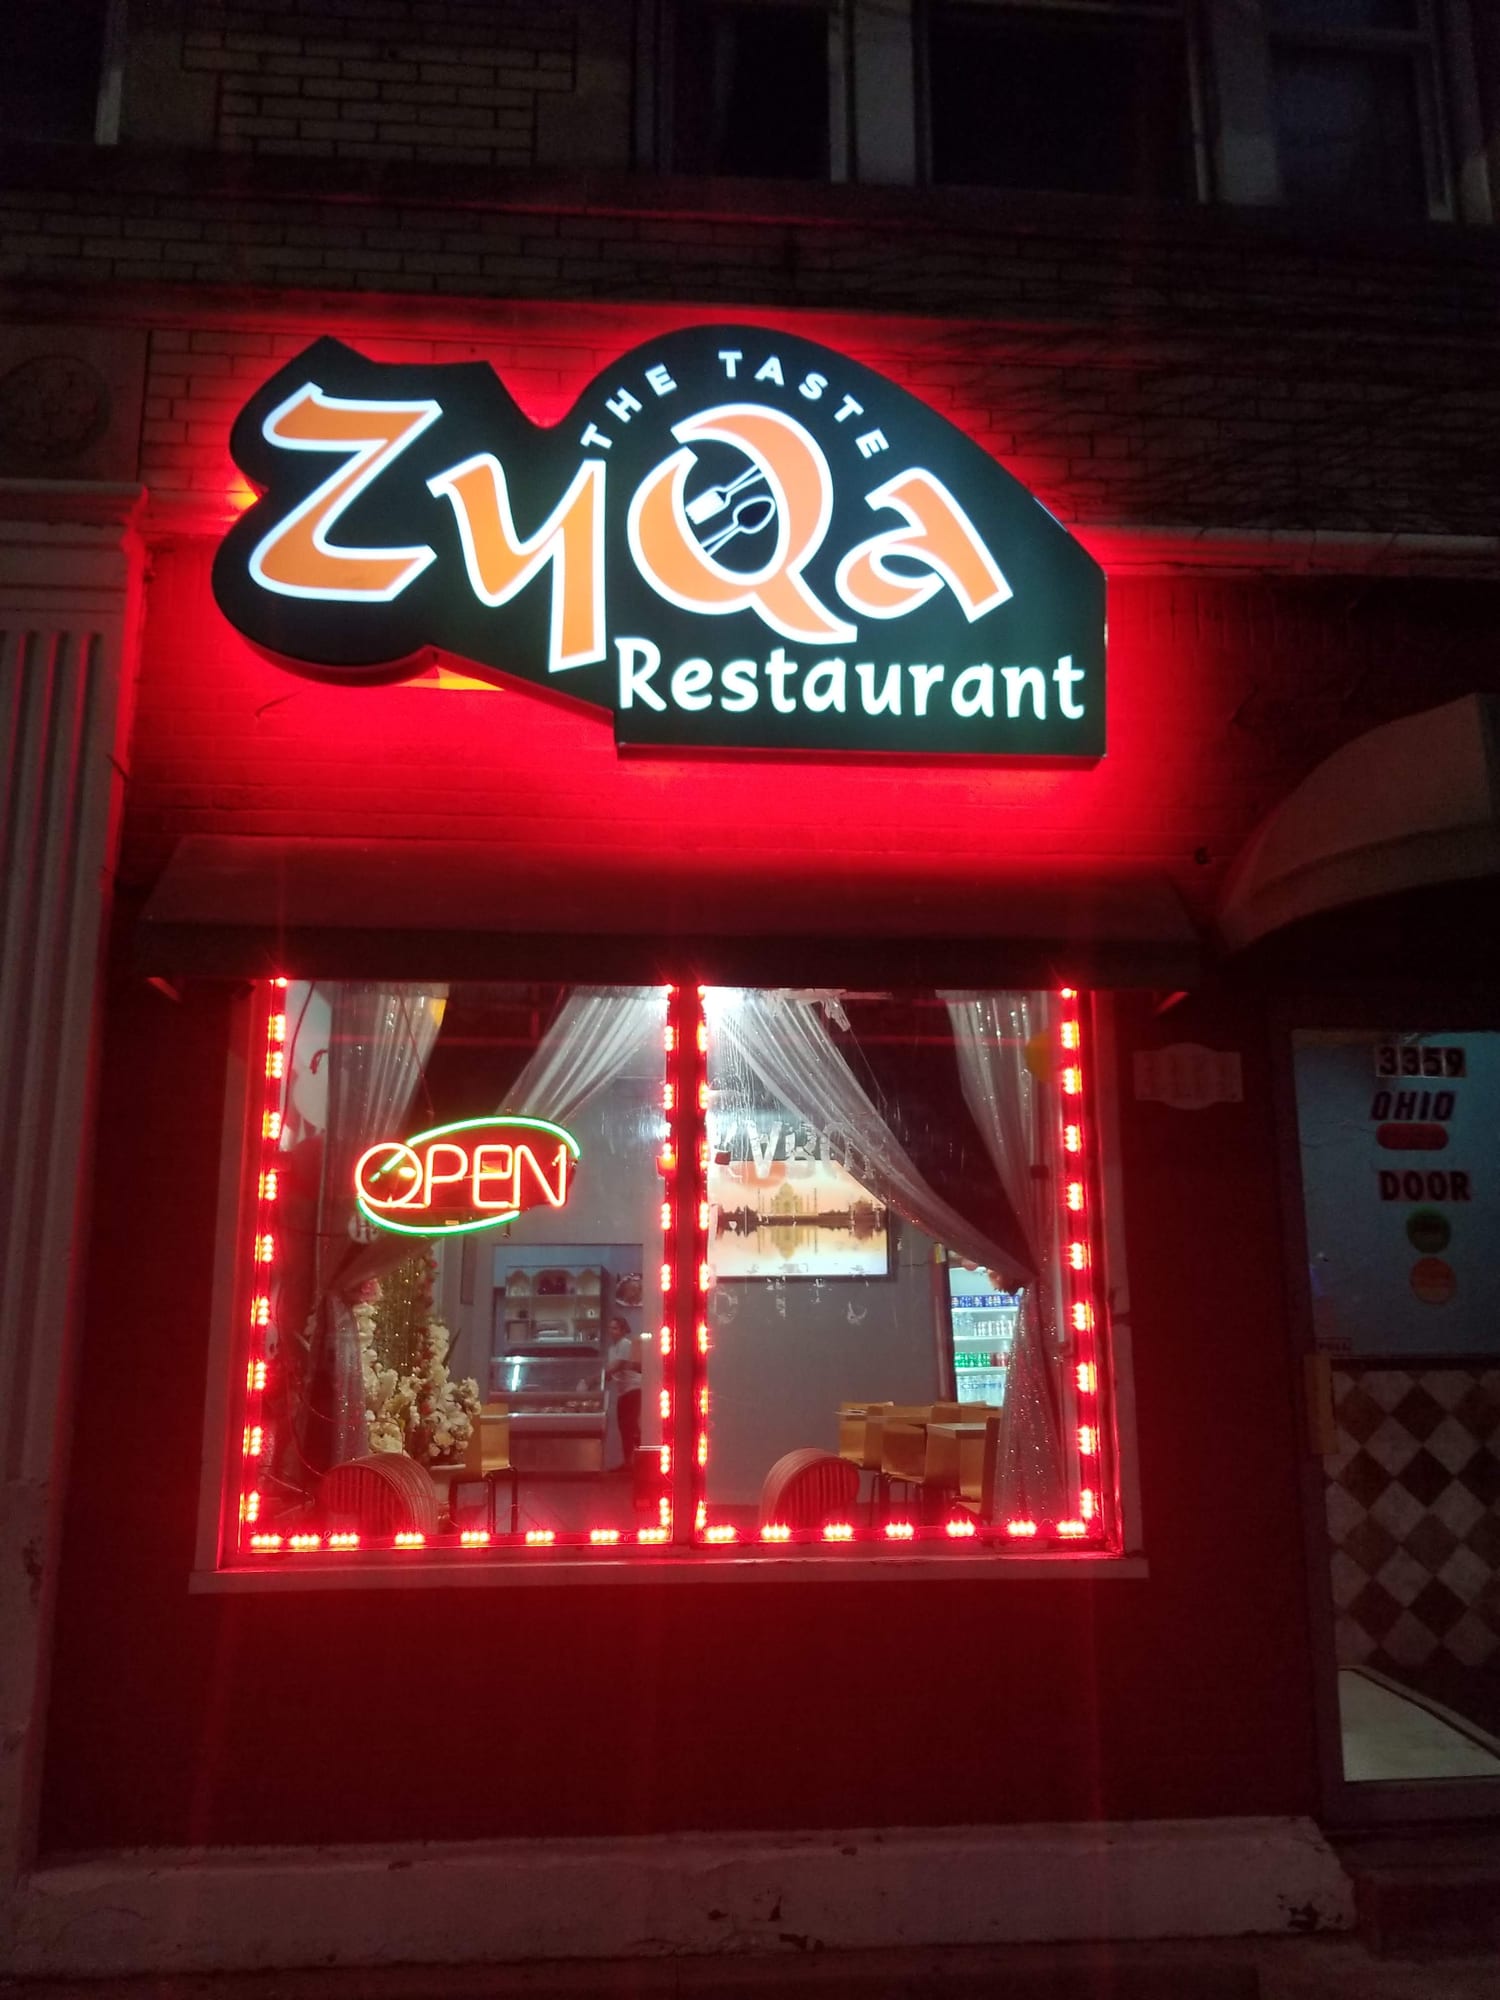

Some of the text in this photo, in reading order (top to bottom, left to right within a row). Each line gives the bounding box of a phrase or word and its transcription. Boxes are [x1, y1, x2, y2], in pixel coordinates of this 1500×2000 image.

[579, 350, 890, 461] THE TASTE
[614, 637, 1086, 721] Restaurant
[1378, 1046, 1465, 1076] 3359
[1370, 1091, 1455, 1121] OHIO
[354, 1141, 568, 1210] OPEN
[1380, 1171, 1470, 1201] DOOR
